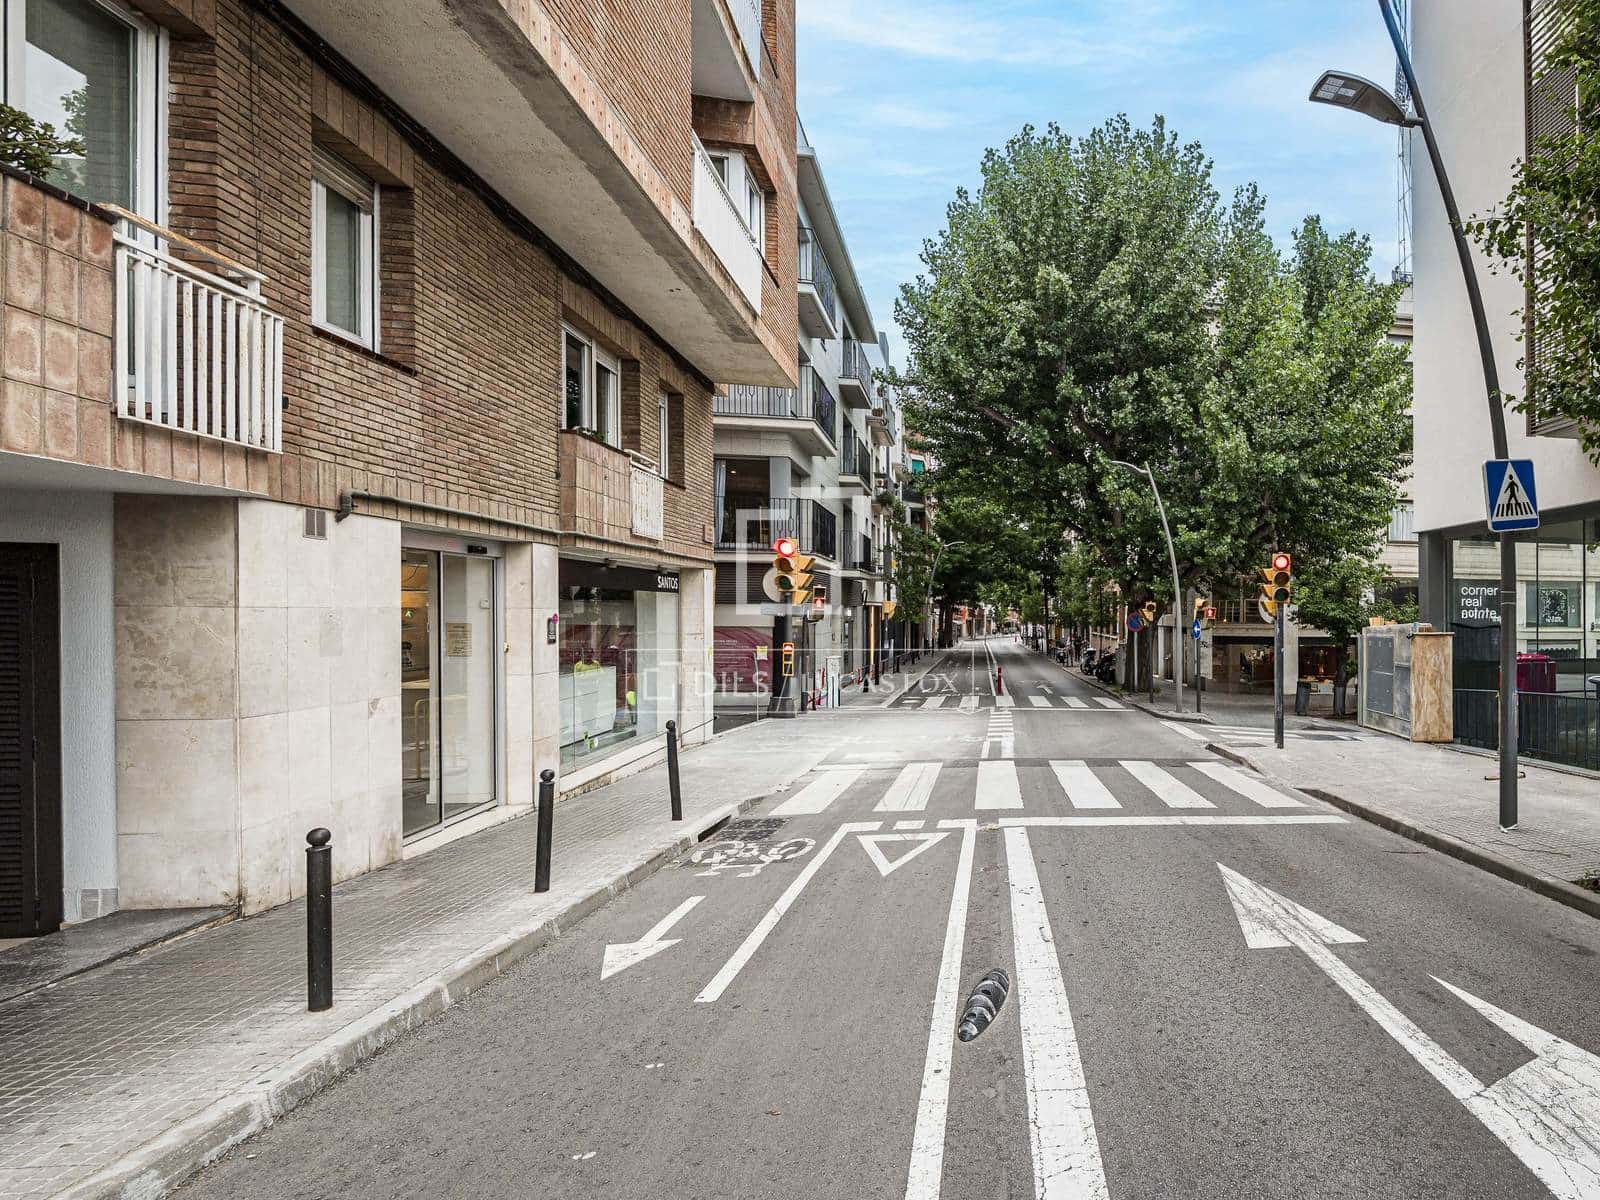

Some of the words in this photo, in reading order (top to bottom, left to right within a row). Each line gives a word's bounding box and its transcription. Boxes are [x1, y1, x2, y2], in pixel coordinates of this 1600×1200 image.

[657, 576, 679, 589] SANTOS
[1461, 586, 1499, 596] corner
[1461, 596, 1482, 607] real
